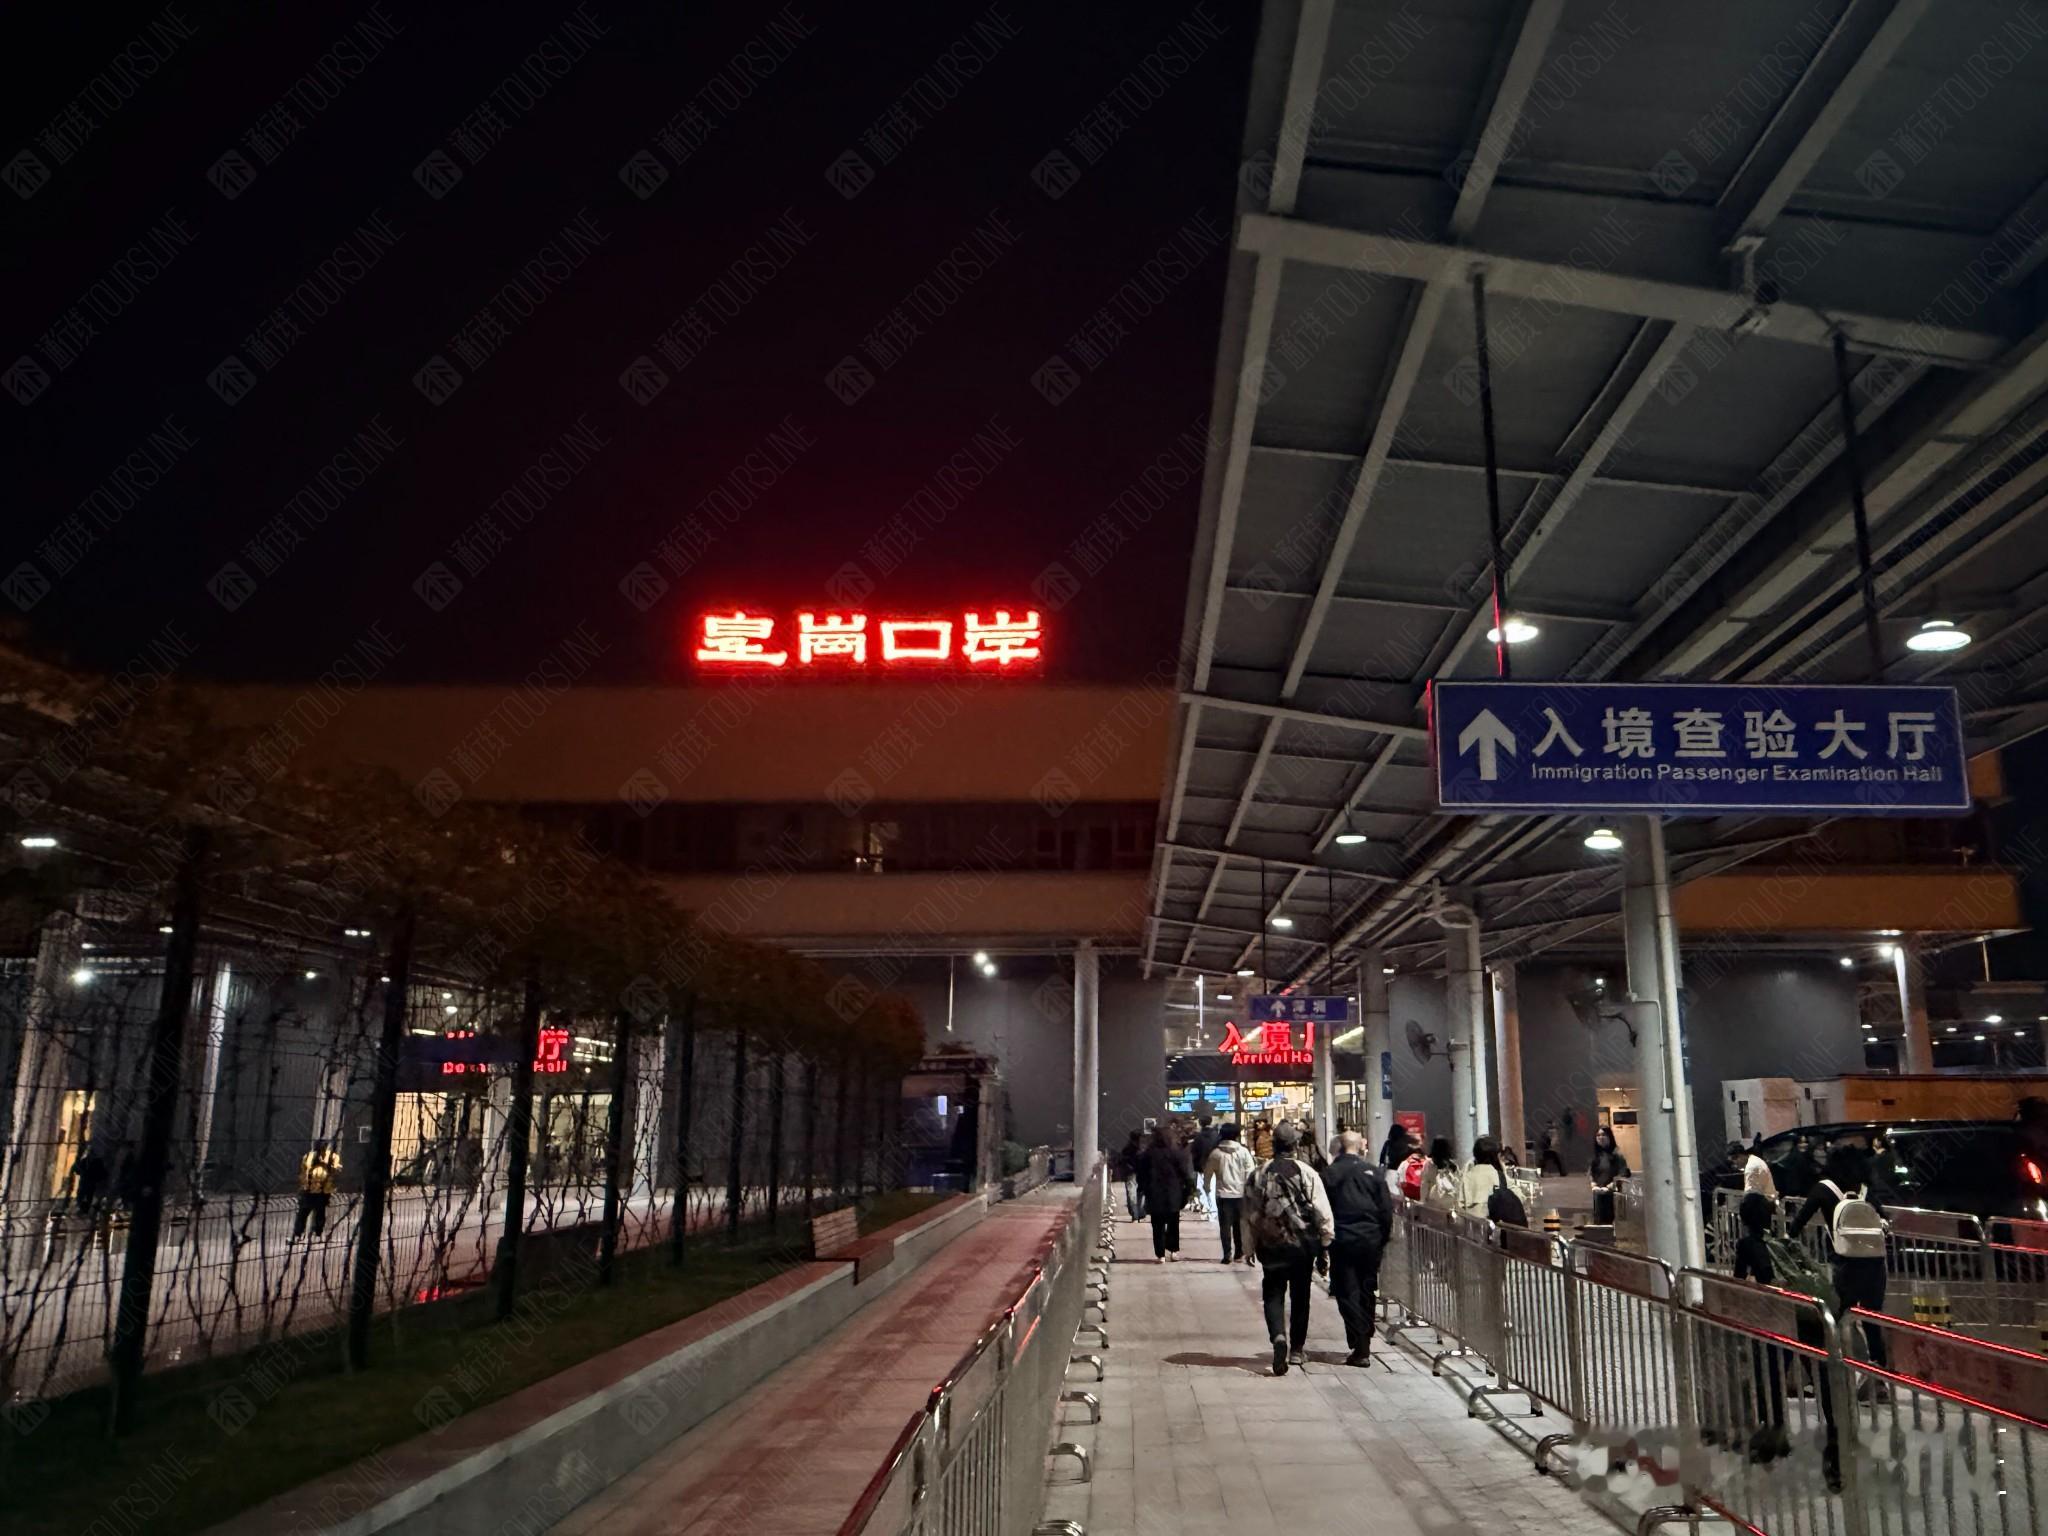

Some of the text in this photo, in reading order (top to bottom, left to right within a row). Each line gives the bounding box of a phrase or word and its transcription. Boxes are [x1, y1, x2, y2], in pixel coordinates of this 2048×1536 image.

[1531, 707, 1937, 760] 入境查验大厅
[1531, 763, 1942, 784] Immigration Passenger Examination Hall
[1218, 1021, 1315, 1053] 入境
[1231, 1051, 1313, 1064] Arrival Ha
